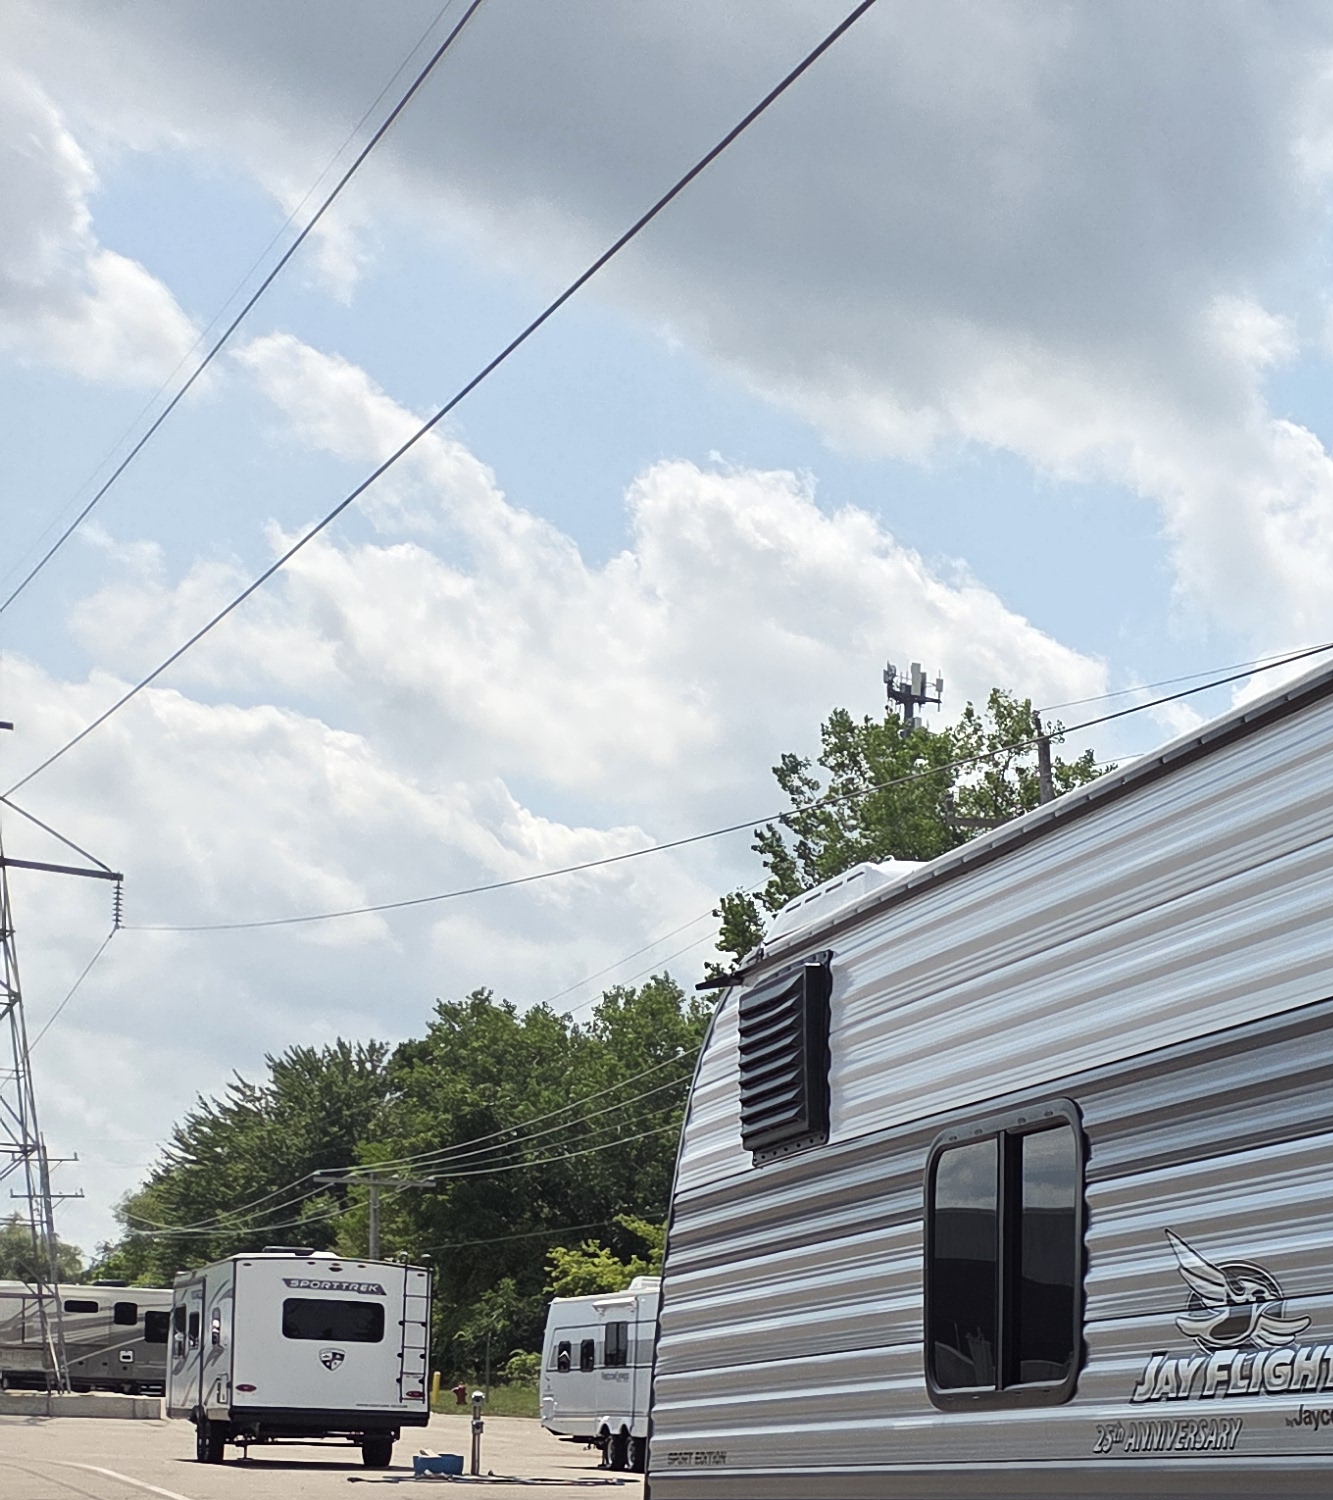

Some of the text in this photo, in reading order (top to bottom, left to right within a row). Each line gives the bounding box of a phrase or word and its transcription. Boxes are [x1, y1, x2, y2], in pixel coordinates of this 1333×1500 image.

[289, 1279, 379, 1292] SPORTTREK
[1093, 1417, 1243, 1453] 25th ANNIVERSARY
